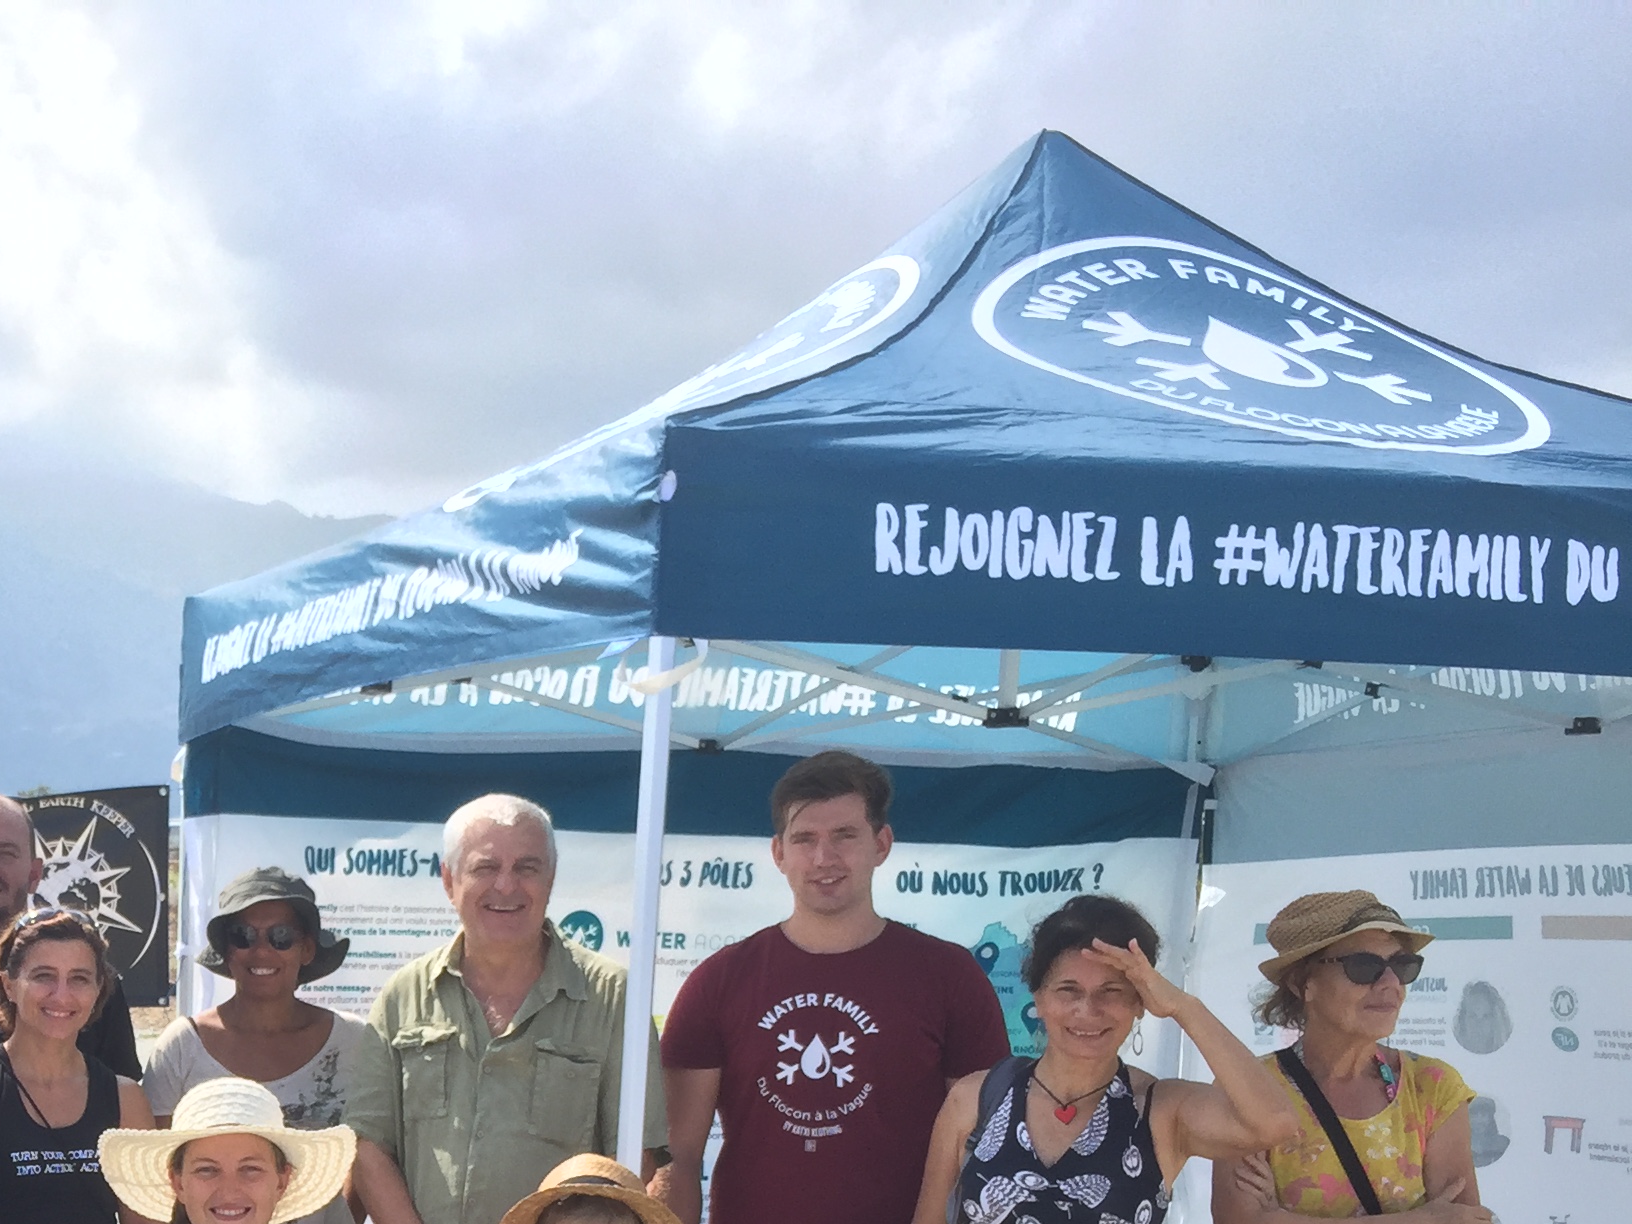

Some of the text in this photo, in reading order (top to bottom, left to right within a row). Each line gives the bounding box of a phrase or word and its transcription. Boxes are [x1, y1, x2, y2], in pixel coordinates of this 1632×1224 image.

[1020, 257, 1375, 336] WATER FAMILY
[875, 502, 1620, 606] REJOIGNEZ LA #WATERFAMILY DU
[39, 796, 86, 809] EARTH
[89, 799, 136, 840] KEEPER
[304, 845, 443, 878] QUI SOMMES-N
[679, 860, 692, 887] 3
[698, 857, 754, 889] PÔLES
[896, 862, 1105, 897] OÙ NOUS TROUVER ?
[616, 931, 687, 950] WER
[757, 992, 880, 1035] WATER FAMILY
[768, 1094, 811, 1121] Flocon
[814, 1110, 823, 1121] à
[826, 1109, 838, 1120] la
[838, 1082, 874, 1116] Vague
[10, 1150, 39, 1163] TURN
[40, 1151, 67, 1161] YOUR
[16, 1164, 42, 1176] INTO
[79, 1162, 100, 1173] ACT
